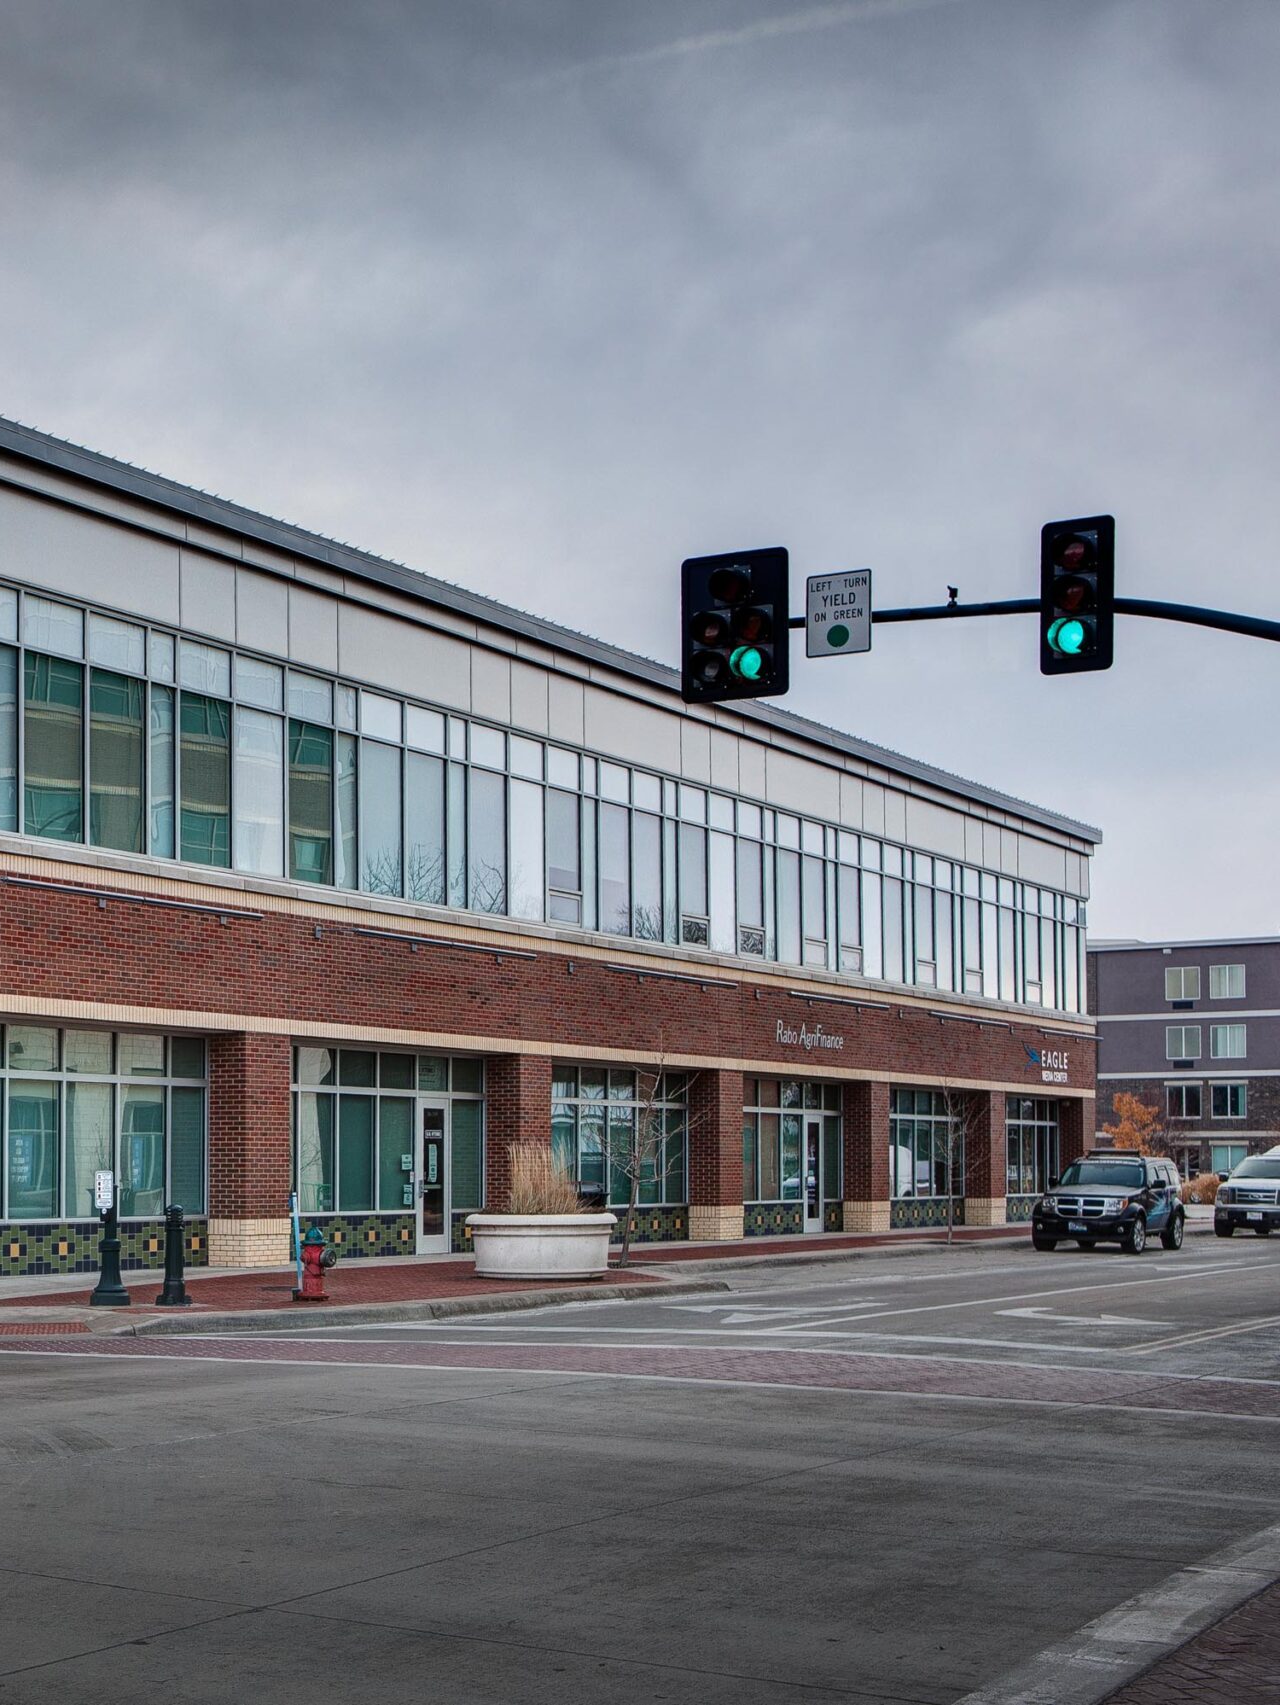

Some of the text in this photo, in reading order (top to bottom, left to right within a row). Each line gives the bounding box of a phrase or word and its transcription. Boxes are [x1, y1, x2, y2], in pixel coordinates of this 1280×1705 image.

[810, 576, 867, 593] LEFT TURN
[822, 592, 856, 608] YIELD
[814, 608, 863, 623] ON GREEN
[776, 1019, 844, 1050] Rabo AgriFinance
[1041, 1050, 1068, 1070] EAGLE
